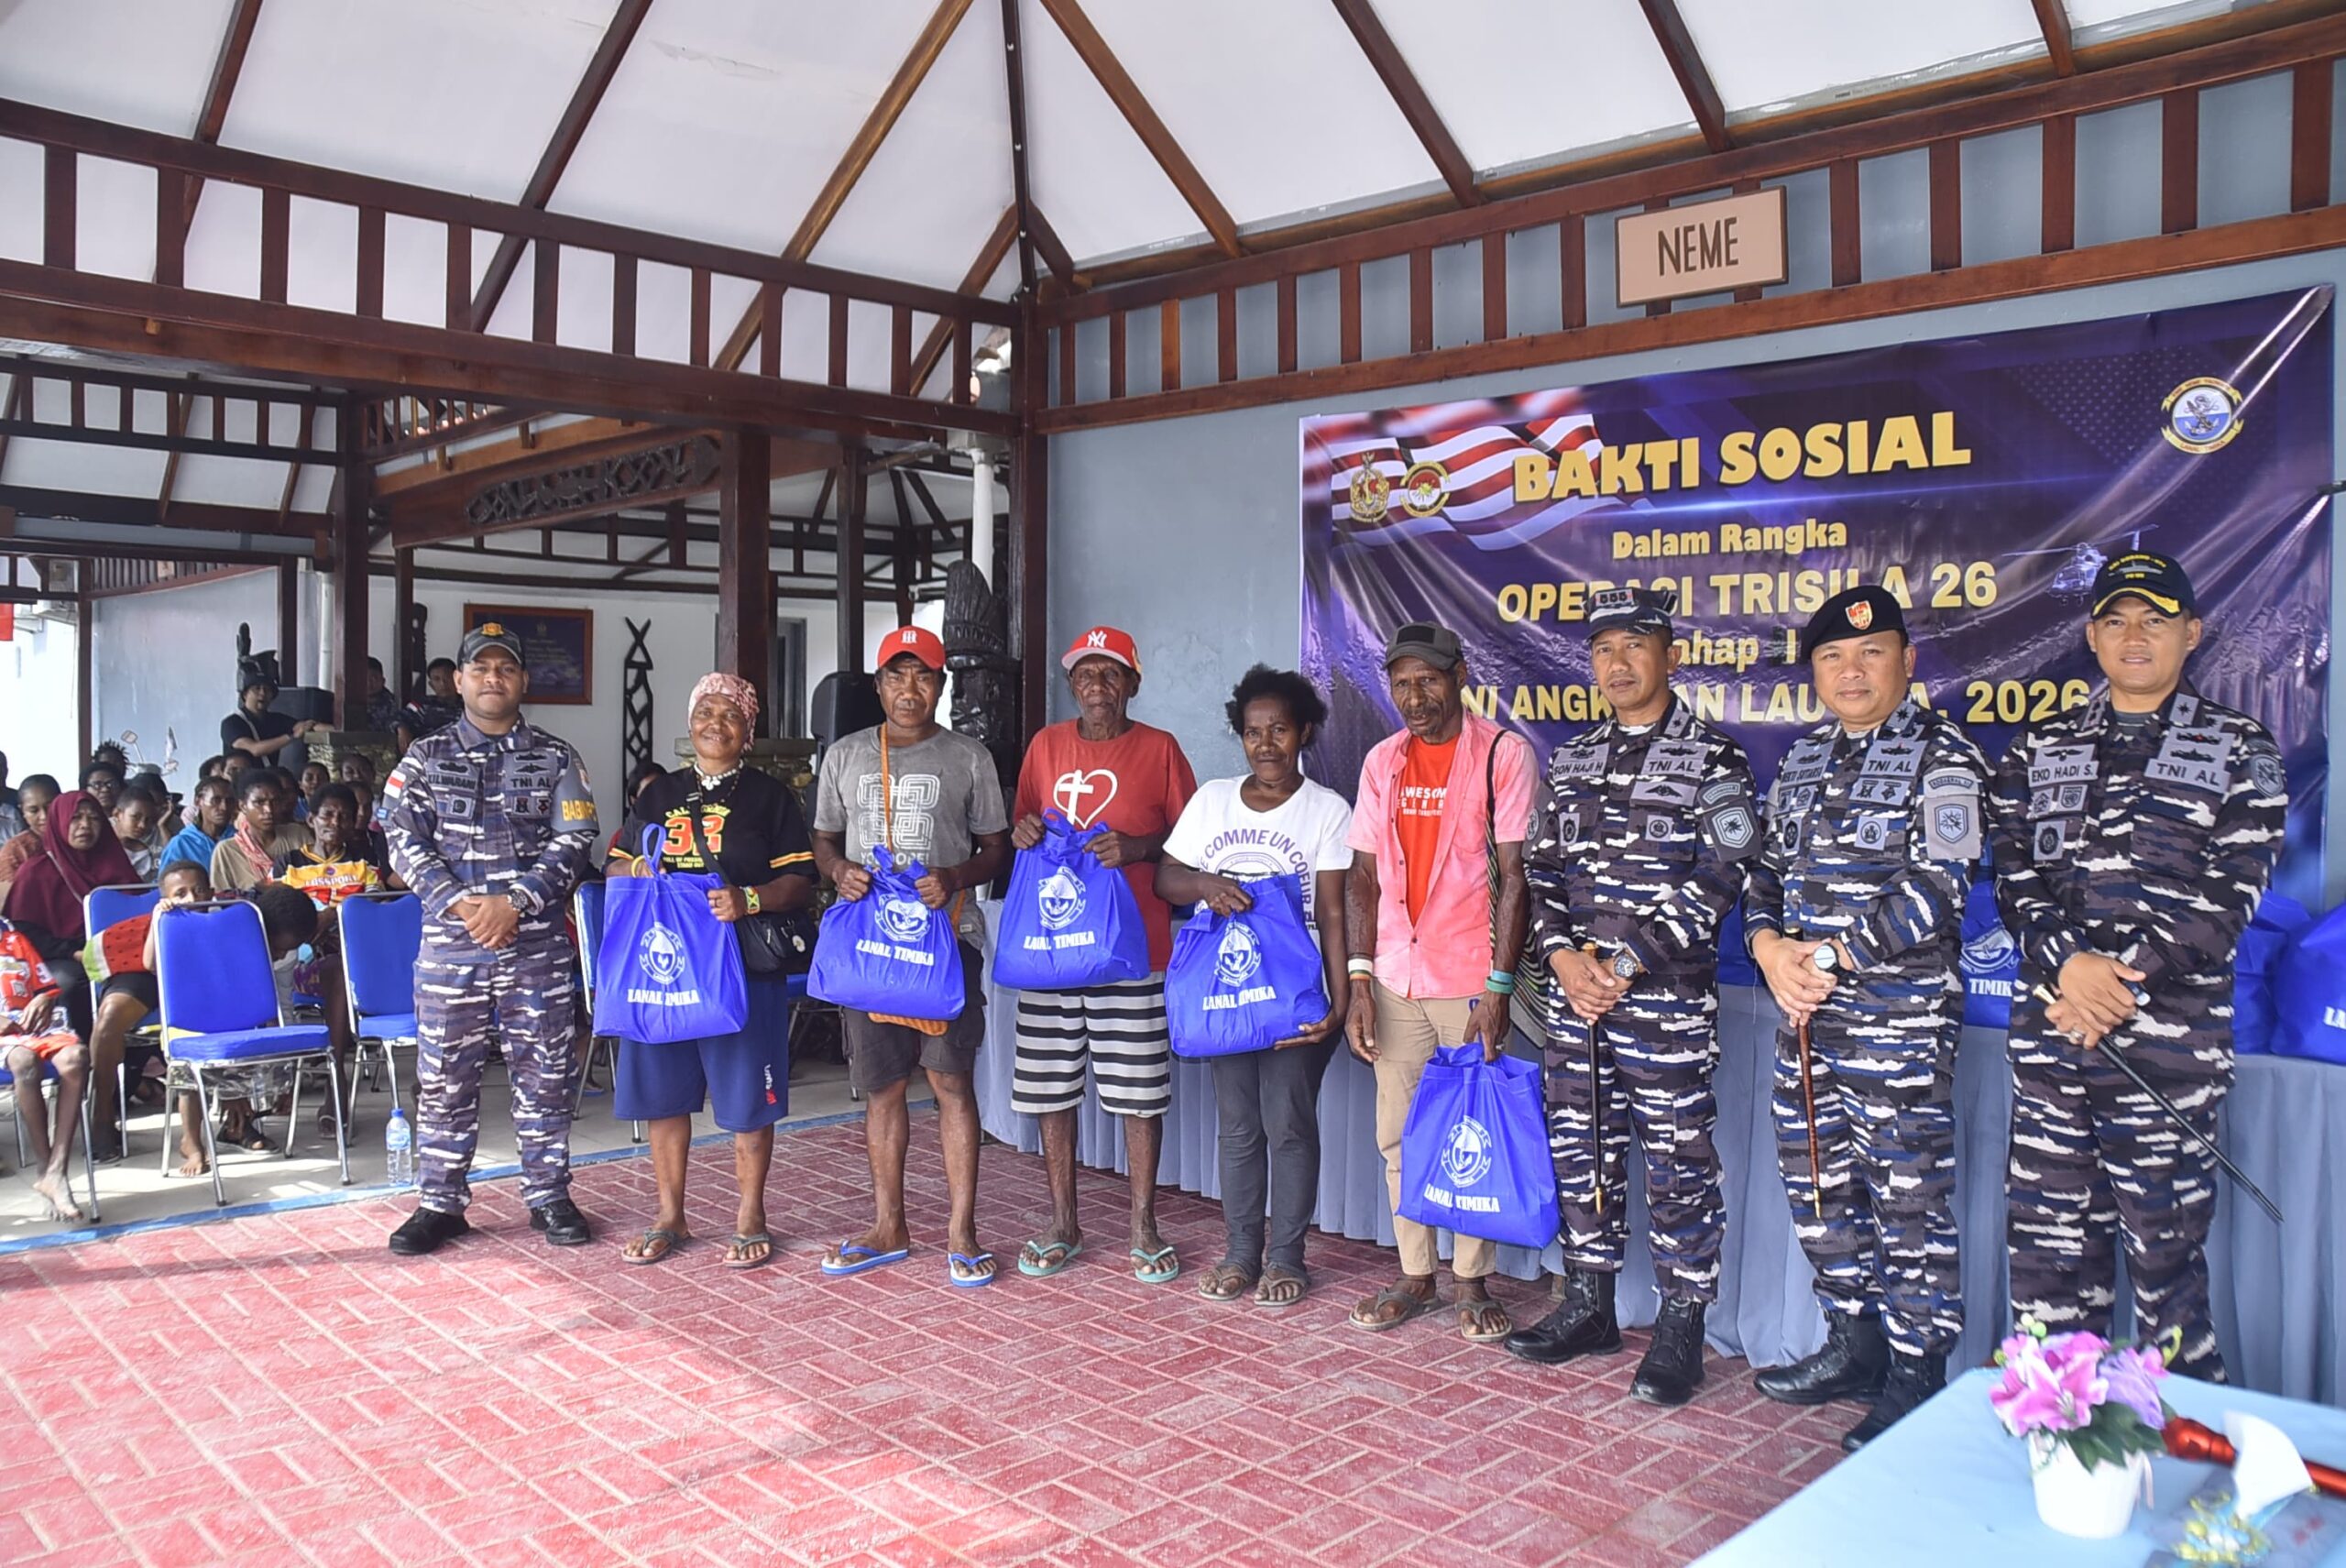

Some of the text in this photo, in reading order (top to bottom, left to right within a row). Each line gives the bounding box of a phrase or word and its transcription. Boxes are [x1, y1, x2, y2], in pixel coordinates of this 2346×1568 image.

[1658, 216, 1738, 276] NEME
[1514, 411, 1971, 503] BAKTI SOSIAL
[1613, 518, 1847, 560] Dalam Rangka
[1497, 576, 1694, 622] OPEI
[1931, 561, 1997, 609] 26
[1672, 629, 1759, 673] ahap
[1460, 685, 1497, 720] NI
[1742, 683, 1825, 722] LAU
[1967, 679, 2089, 723] 2026
[1650, 761, 1695, 773] TNI AL
[1869, 760, 1912, 773] TNI AL
[2032, 767, 2050, 783] EKO
[2055, 765, 2080, 779] HADI
[2157, 762, 2220, 786] TNI AL
[510, 777, 552, 788] TNI AL
[1205, 828, 1270, 859] COMME
[1269, 832, 1295, 854] UN
[856, 938, 935, 967] LANAL TIMIKA
[1053, 931, 1095, 950] TIMIKA
[627, 988, 663, 1005] LANAL
[1968, 978, 2013, 997] TIMIK
[1202, 992, 1238, 1012] LANAL
[1423, 1183, 1501, 1213] LANAL TIMIKA
